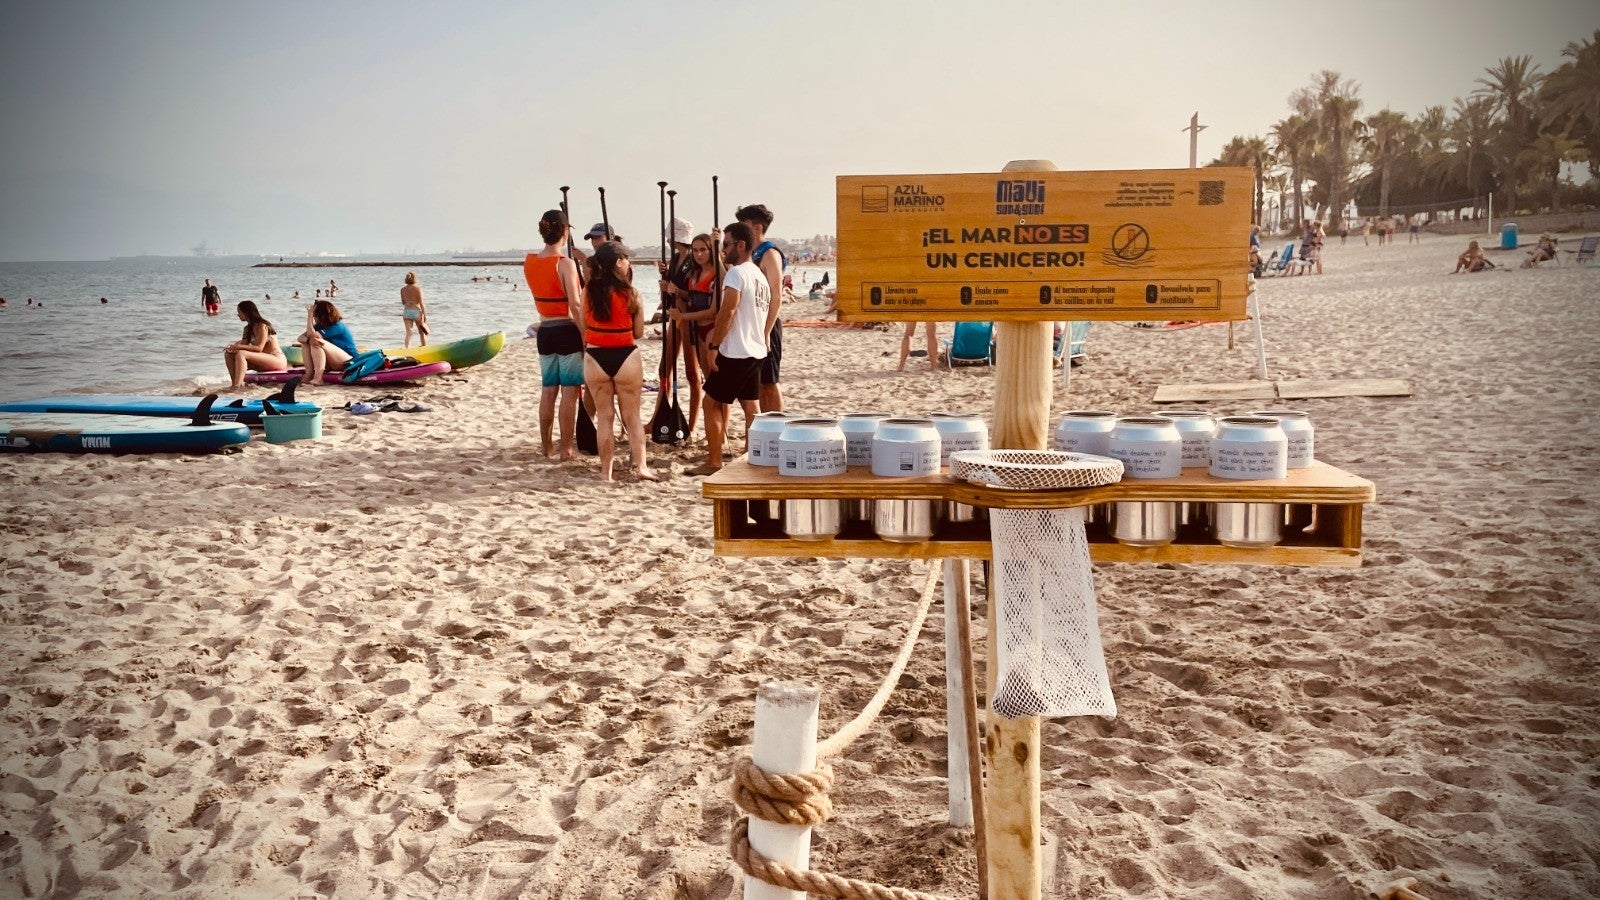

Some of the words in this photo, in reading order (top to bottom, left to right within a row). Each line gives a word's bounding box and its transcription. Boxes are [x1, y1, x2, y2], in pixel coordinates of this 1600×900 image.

[894, 185, 927, 195] AZUL
[894, 196, 945, 206] MARINO
[923, 228, 954, 247] ¡EL
[961, 228, 1010, 243] MAR
[1018, 226, 1052, 243] NO
[1058, 226, 1086, 243] ES
[926, 252, 957, 268] UN
[964, 251, 1085, 268] CENICERO!
[82, 437, 110, 448] NUMA
